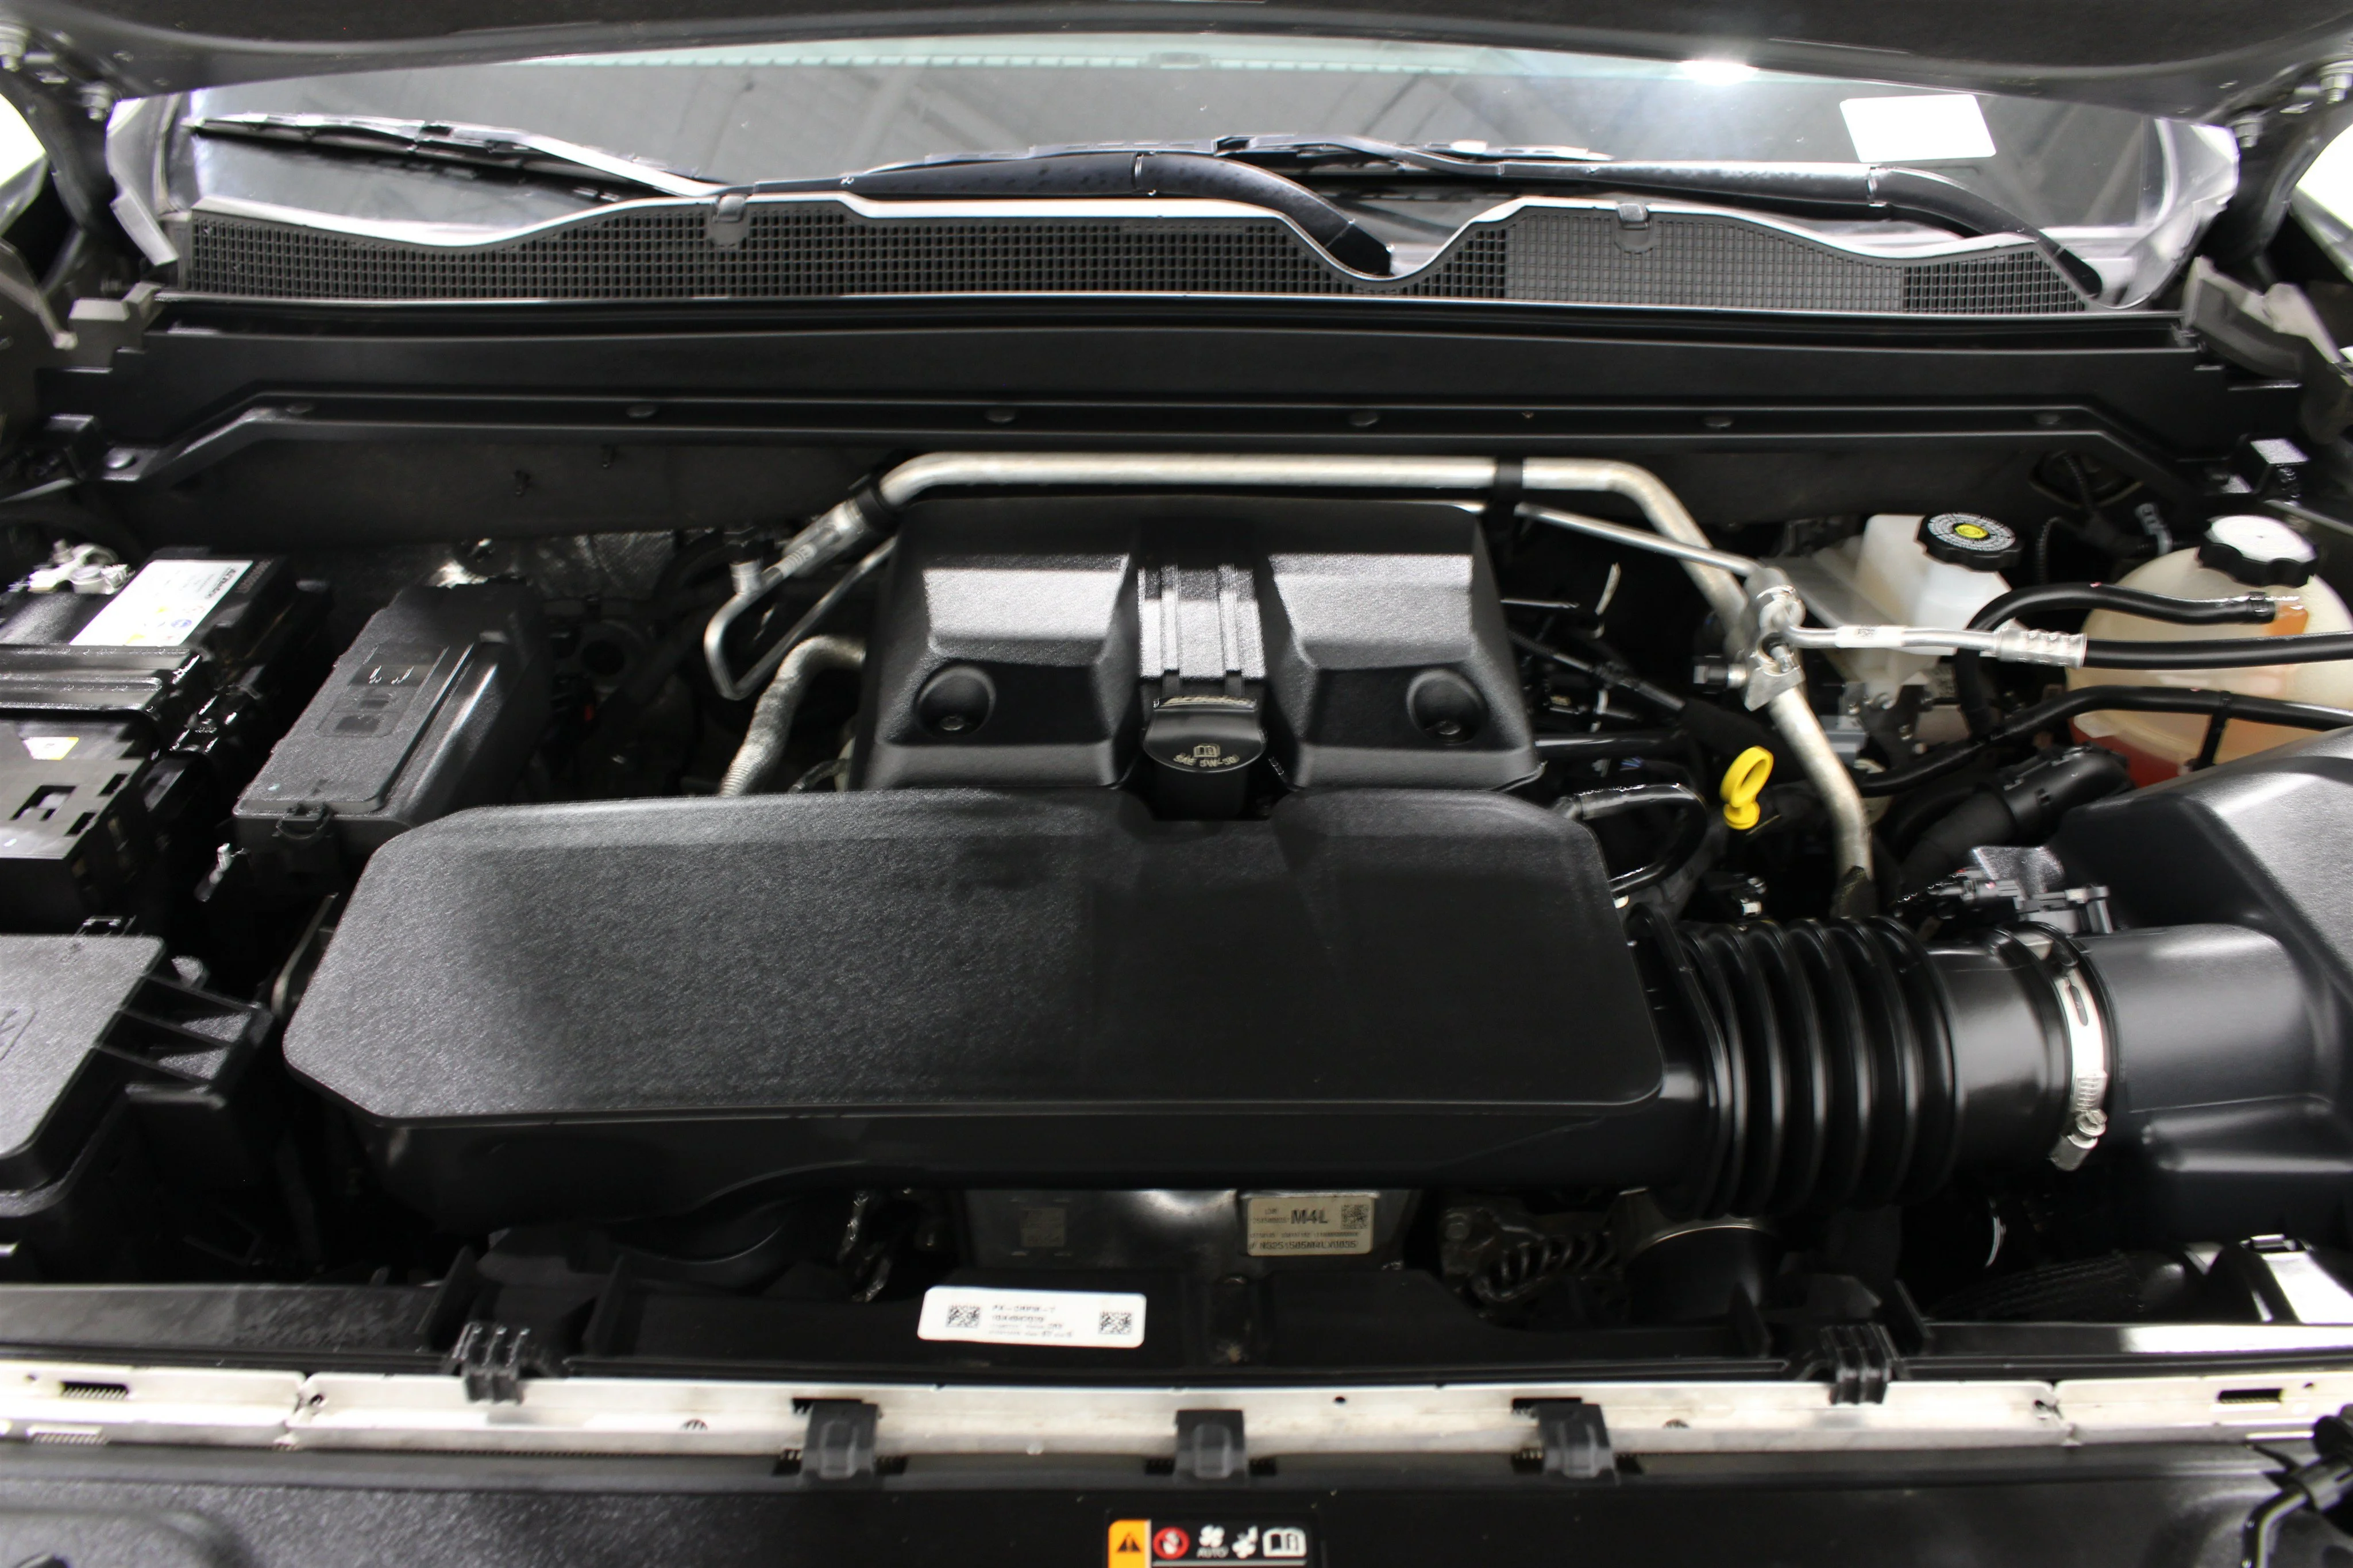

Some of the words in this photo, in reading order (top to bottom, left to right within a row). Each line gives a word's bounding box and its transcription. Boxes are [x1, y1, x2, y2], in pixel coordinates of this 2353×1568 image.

[1172, 752, 1197, 766] SAE
[1199, 755, 1240, 767] 5W-30
[1291, 1208, 1328, 1224] M4L
[1197, 1546, 1229, 1558] AUTO
